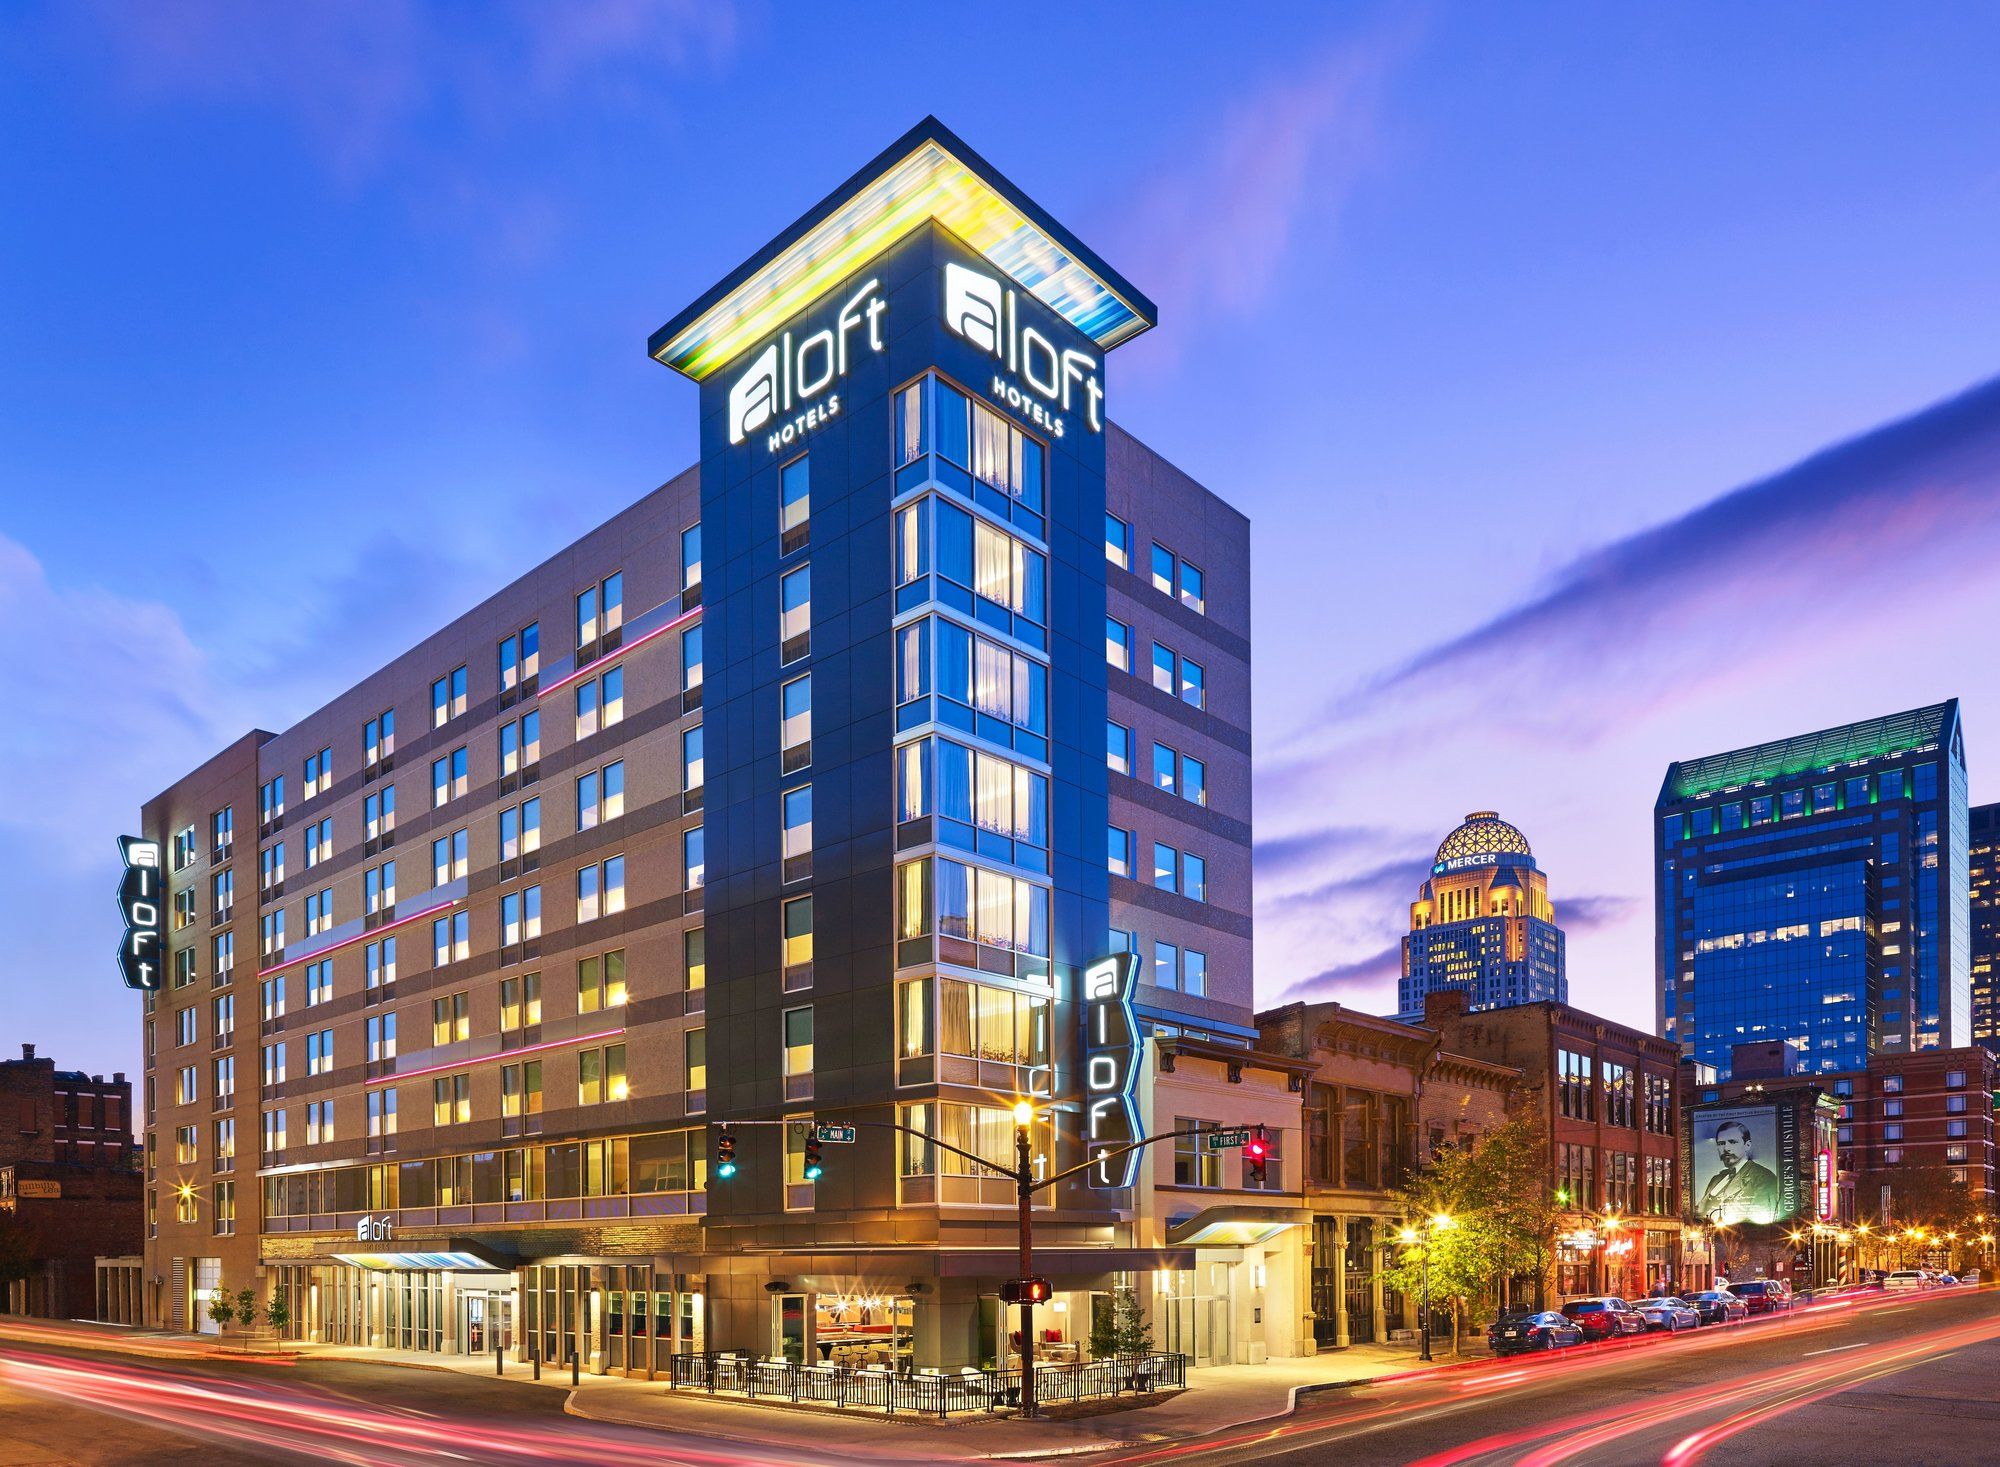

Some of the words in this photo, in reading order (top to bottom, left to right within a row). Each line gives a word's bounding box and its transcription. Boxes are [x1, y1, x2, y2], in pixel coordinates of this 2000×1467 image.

[729, 278, 886, 445] aloft
[946, 262, 1103, 433] aloft
[768, 395, 840, 453] HOTELS
[994, 376, 1064, 438] HOTELS
[1447, 854, 1496, 870] MERCER
[830, 1130, 843, 1140] MAIN
[1220, 1135, 1238, 1146] FIRST
[1782, 1105, 1794, 1162] LOUISVILLE
[1783, 1164, 1795, 1212] GEORGE'S
[358, 1215, 392, 1241] aloft
[364, 1243, 390, 1252] HOTELS
